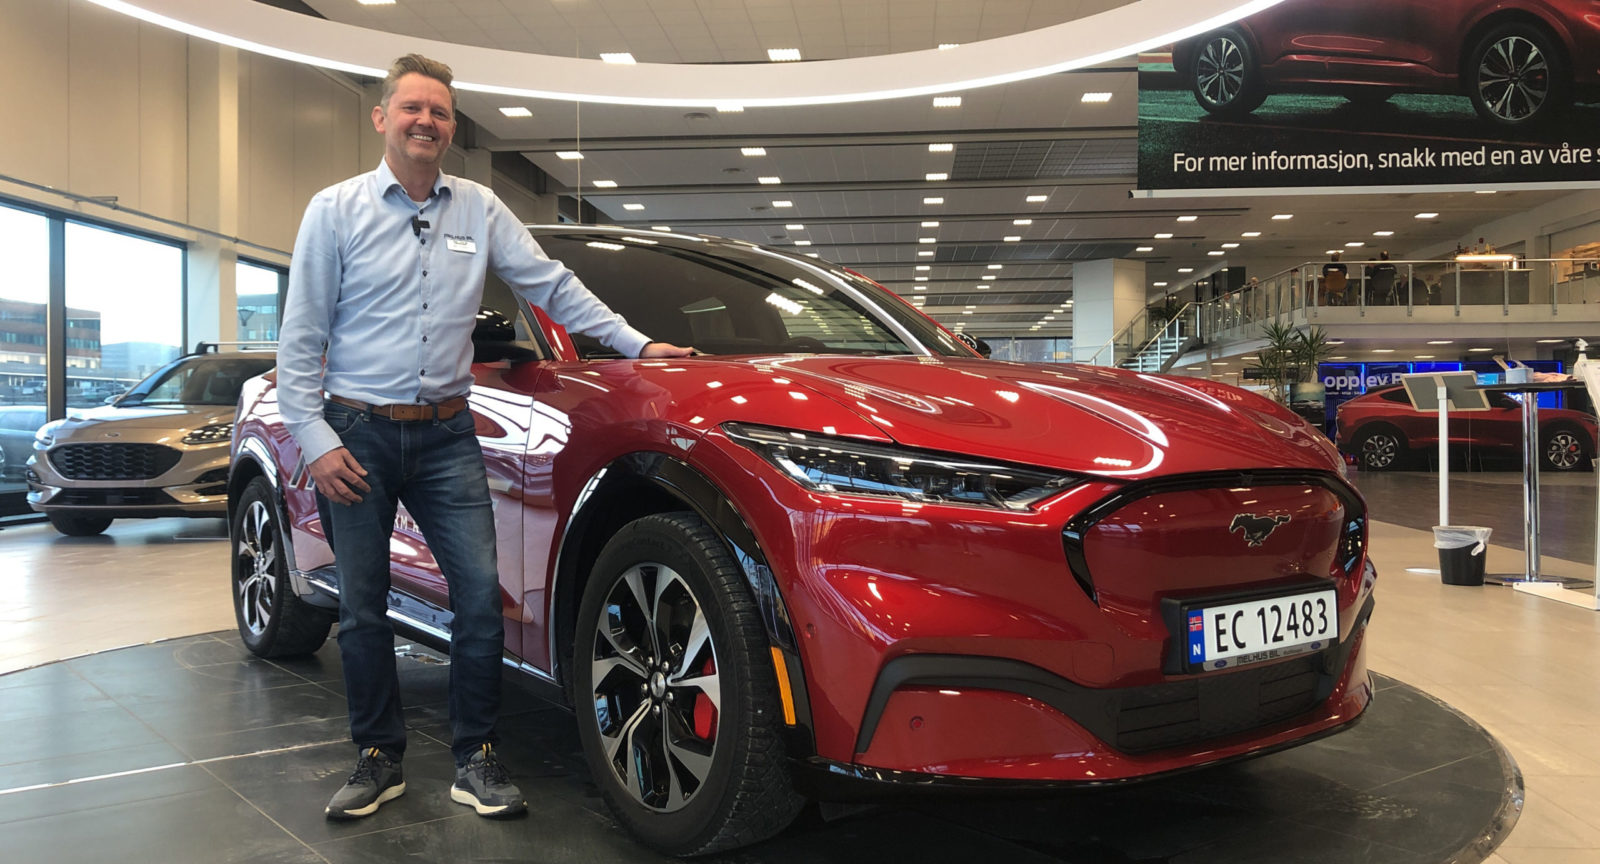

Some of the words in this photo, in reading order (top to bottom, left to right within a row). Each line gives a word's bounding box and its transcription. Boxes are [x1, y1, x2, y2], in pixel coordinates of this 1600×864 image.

[1173, 152, 1204, 172] For
[1209, 155, 1247, 171] mer
[1252, 149, 1374, 173] informasjon,
[1378, 147, 1436, 168] snakk
[1441, 145, 1486, 167] med
[1490, 149, 1515, 166] en
[1520, 148, 1544, 165] av
[1548, 142, 1592, 164] våre
[1324, 372, 1388, 391] opplev
[1214, 610, 1247, 653] EC
[1256, 598, 1328, 645] 12483
[1192, 643, 1201, 656] N
[1236, 651, 1268, 666] MELHUS
[1269, 649, 1281, 660] BIL
